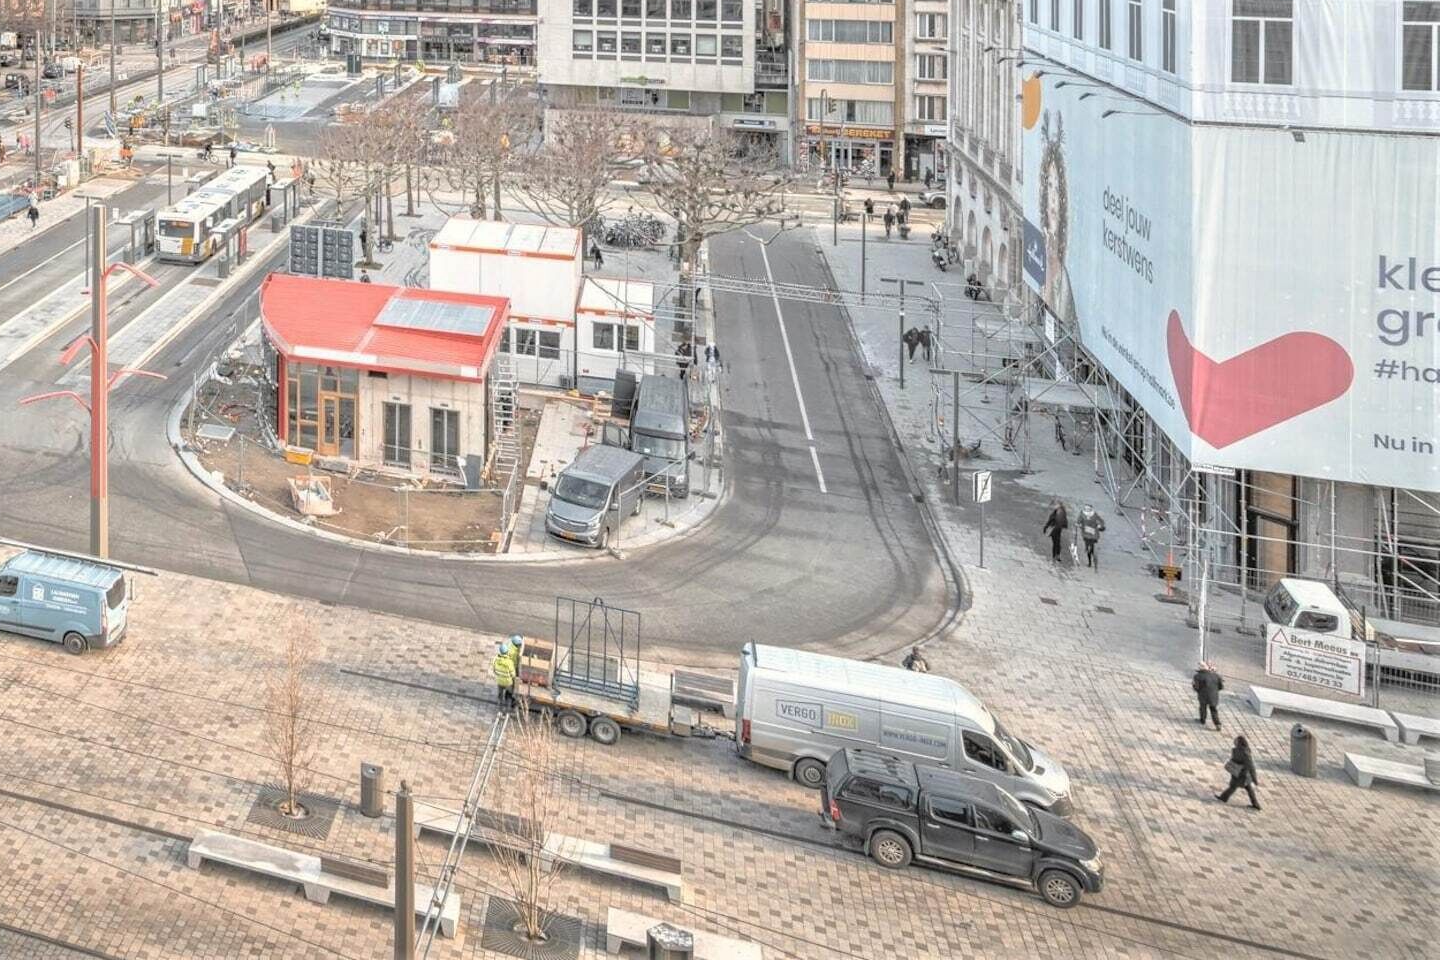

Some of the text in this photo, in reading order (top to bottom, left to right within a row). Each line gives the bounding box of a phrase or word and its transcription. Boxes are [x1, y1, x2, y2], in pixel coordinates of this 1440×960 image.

[1103, 185, 1151, 242] deel jouw
[1103, 219, 1153, 284] kerstwens
[1373, 433, 1433, 455] Nu in
[1290, 634, 1311, 647] Bert
[1314, 640, 1348, 655] Meeus
[781, 703, 817, 721] VERGO
